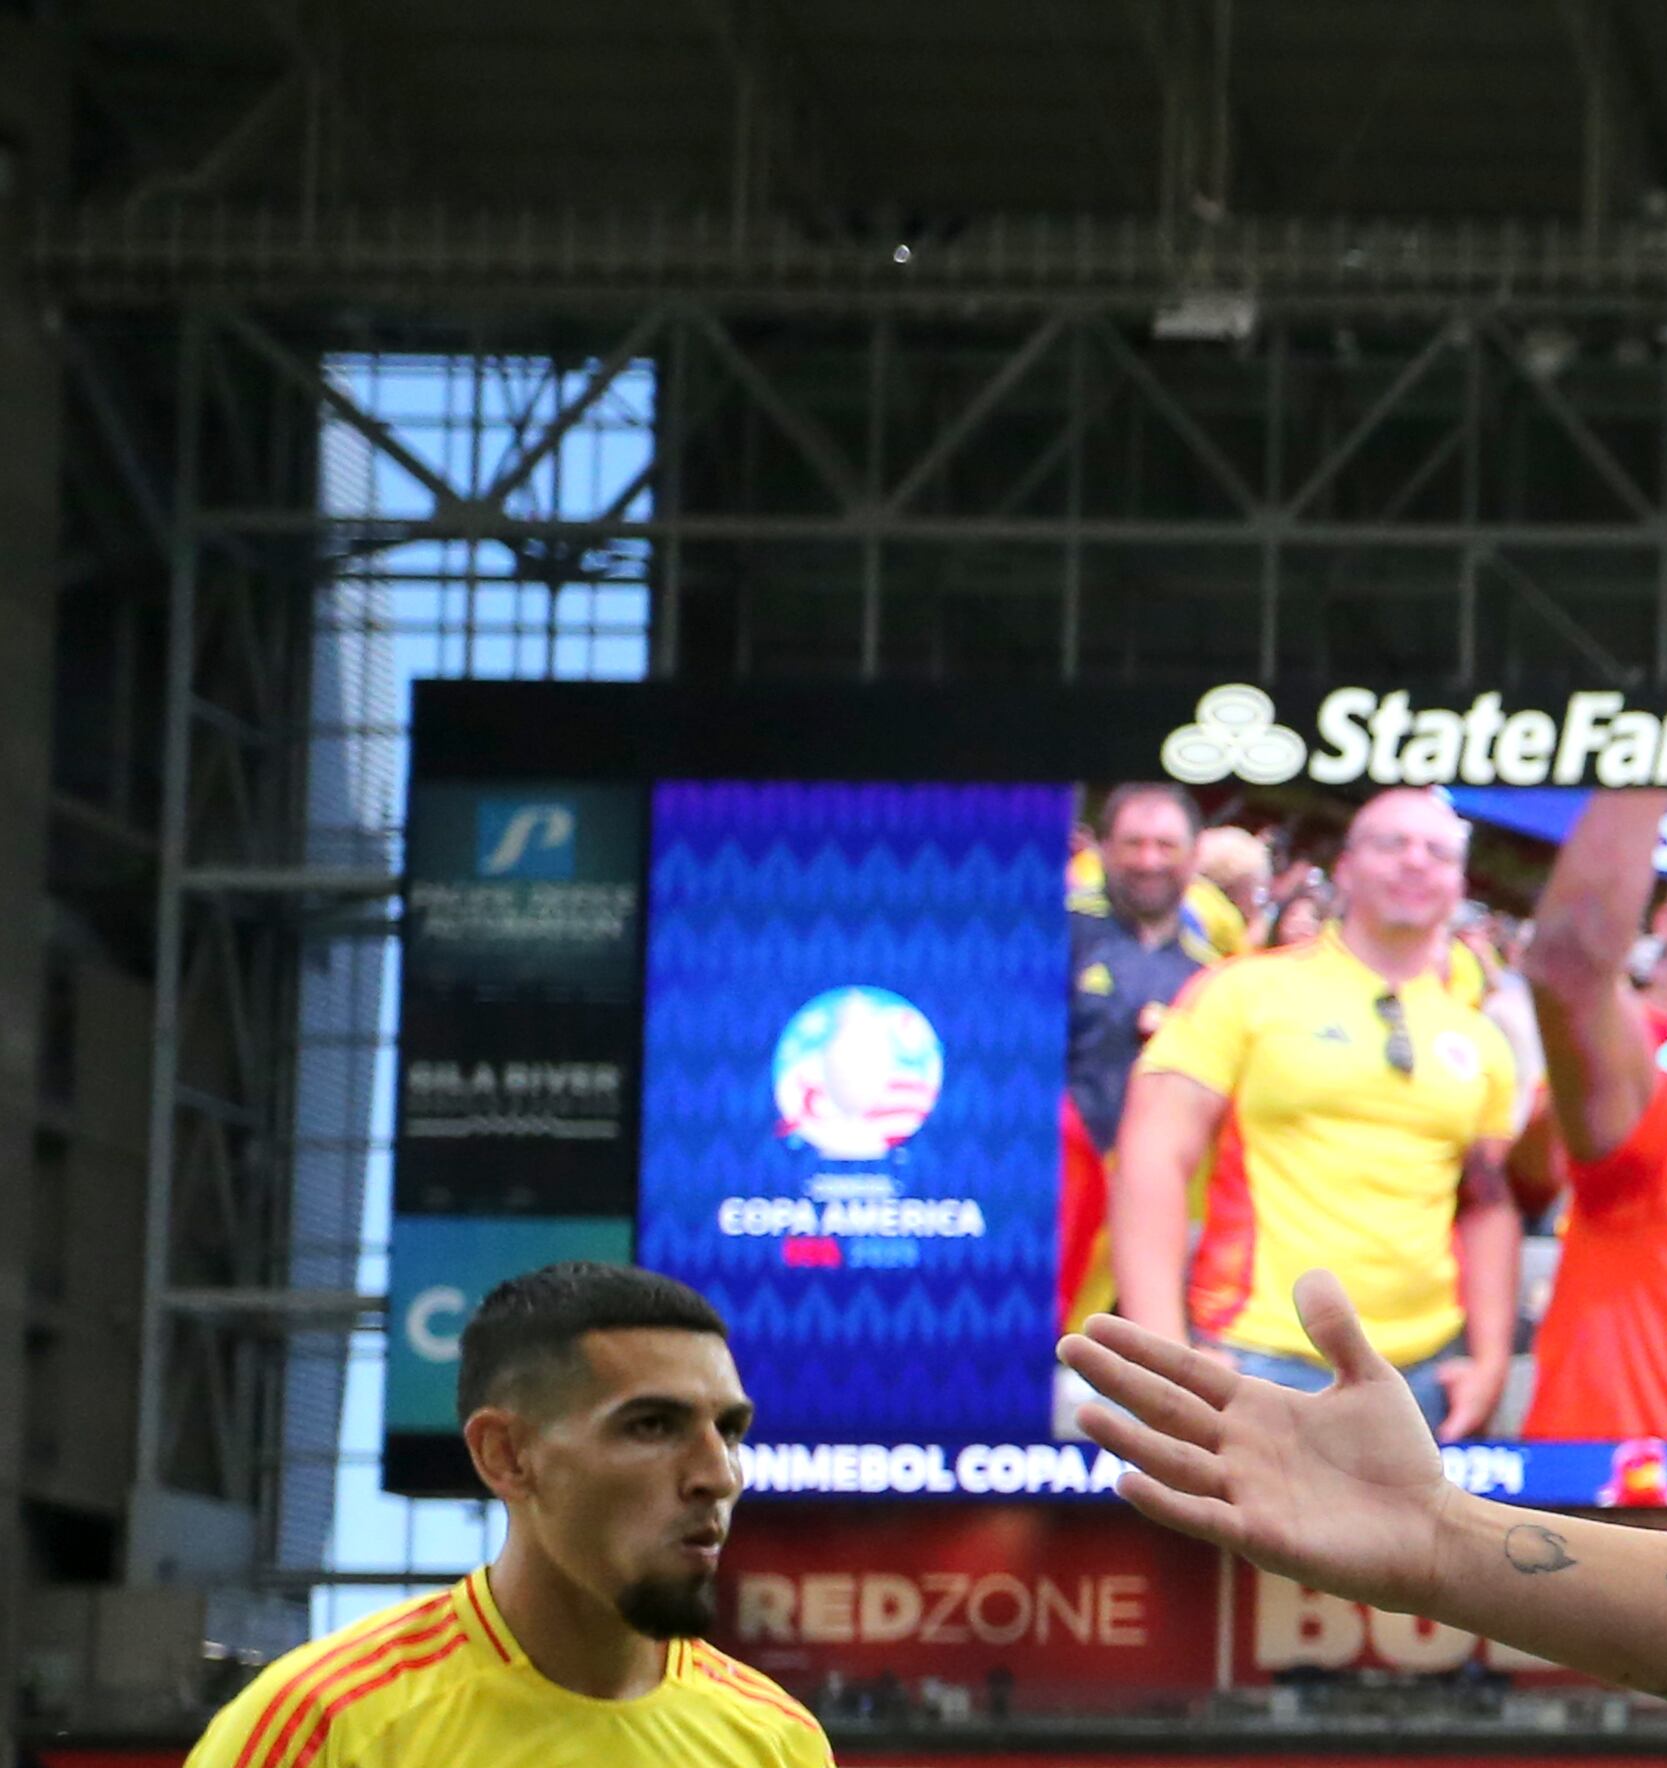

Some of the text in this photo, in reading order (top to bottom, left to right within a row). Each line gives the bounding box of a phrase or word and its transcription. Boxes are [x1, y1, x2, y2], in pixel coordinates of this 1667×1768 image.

[717, 1196, 987, 1238] COPA AMERICA
[956, 1443, 1087, 1494] COPA
